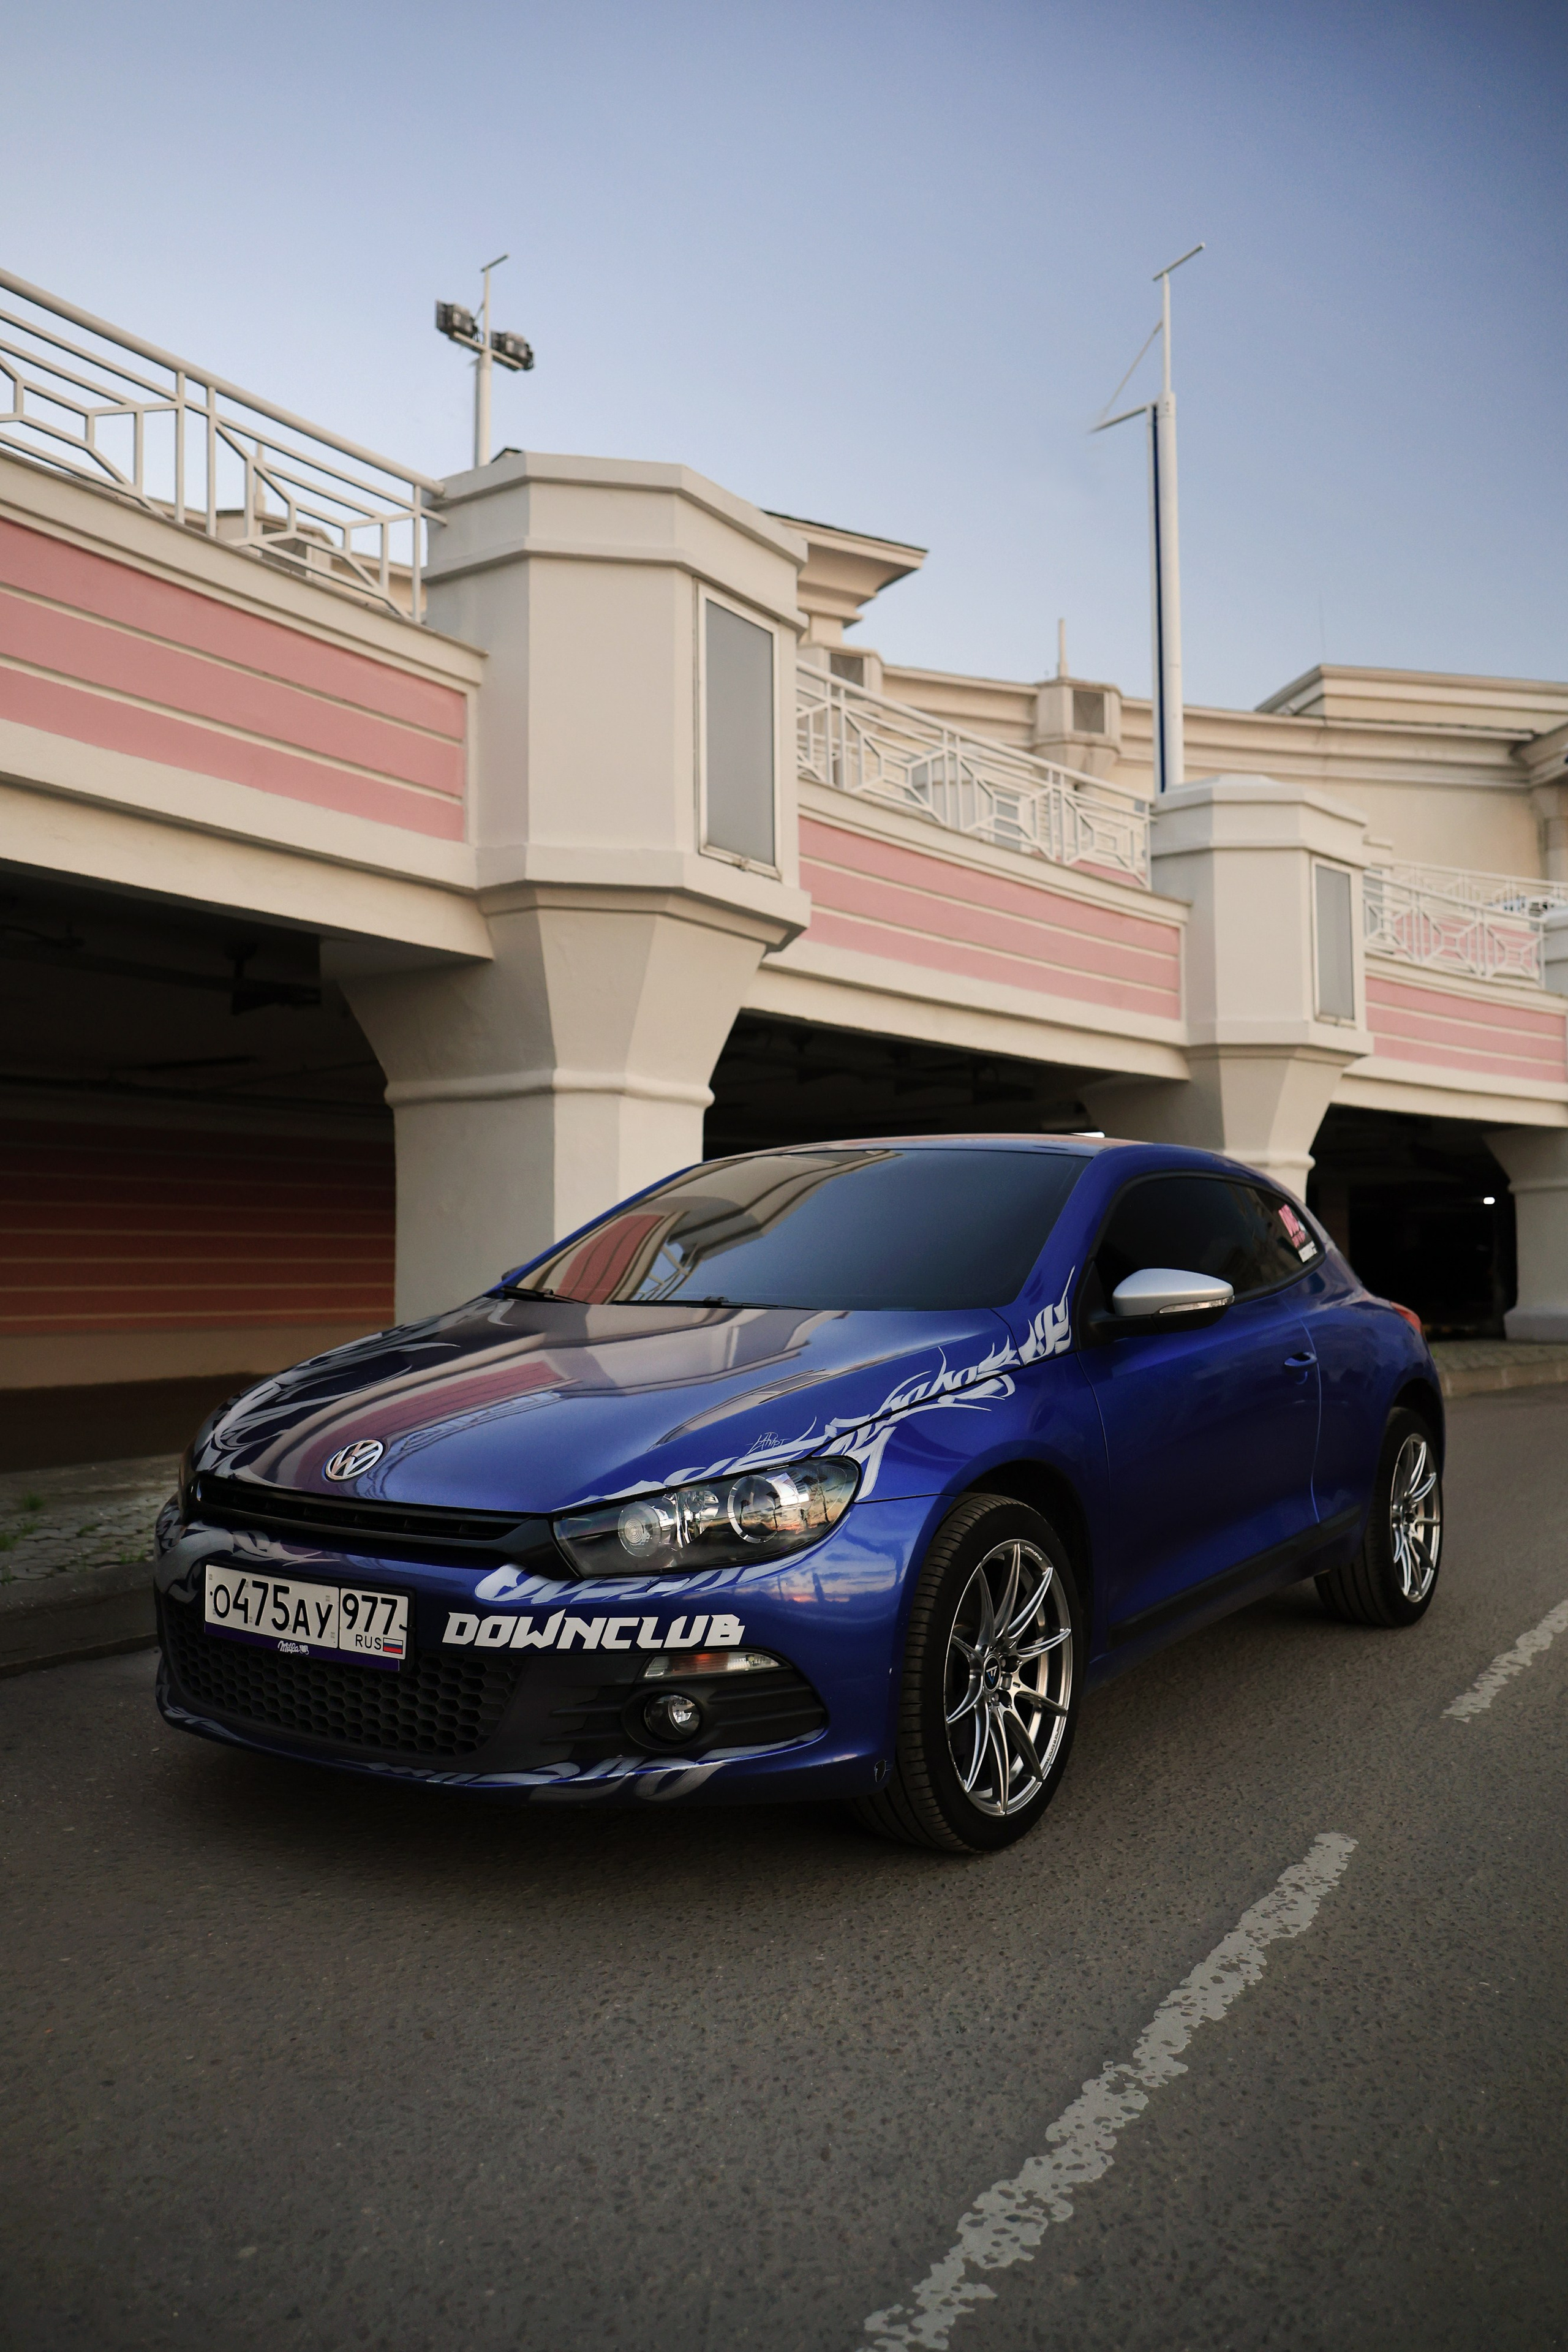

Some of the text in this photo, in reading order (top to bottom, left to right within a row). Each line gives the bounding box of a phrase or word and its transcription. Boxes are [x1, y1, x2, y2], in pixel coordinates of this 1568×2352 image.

[342, 1593, 398, 1635] 977
[442, 1608, 745, 1649] DOWNCLUB
[355, 1634, 382, 1650] RUS
